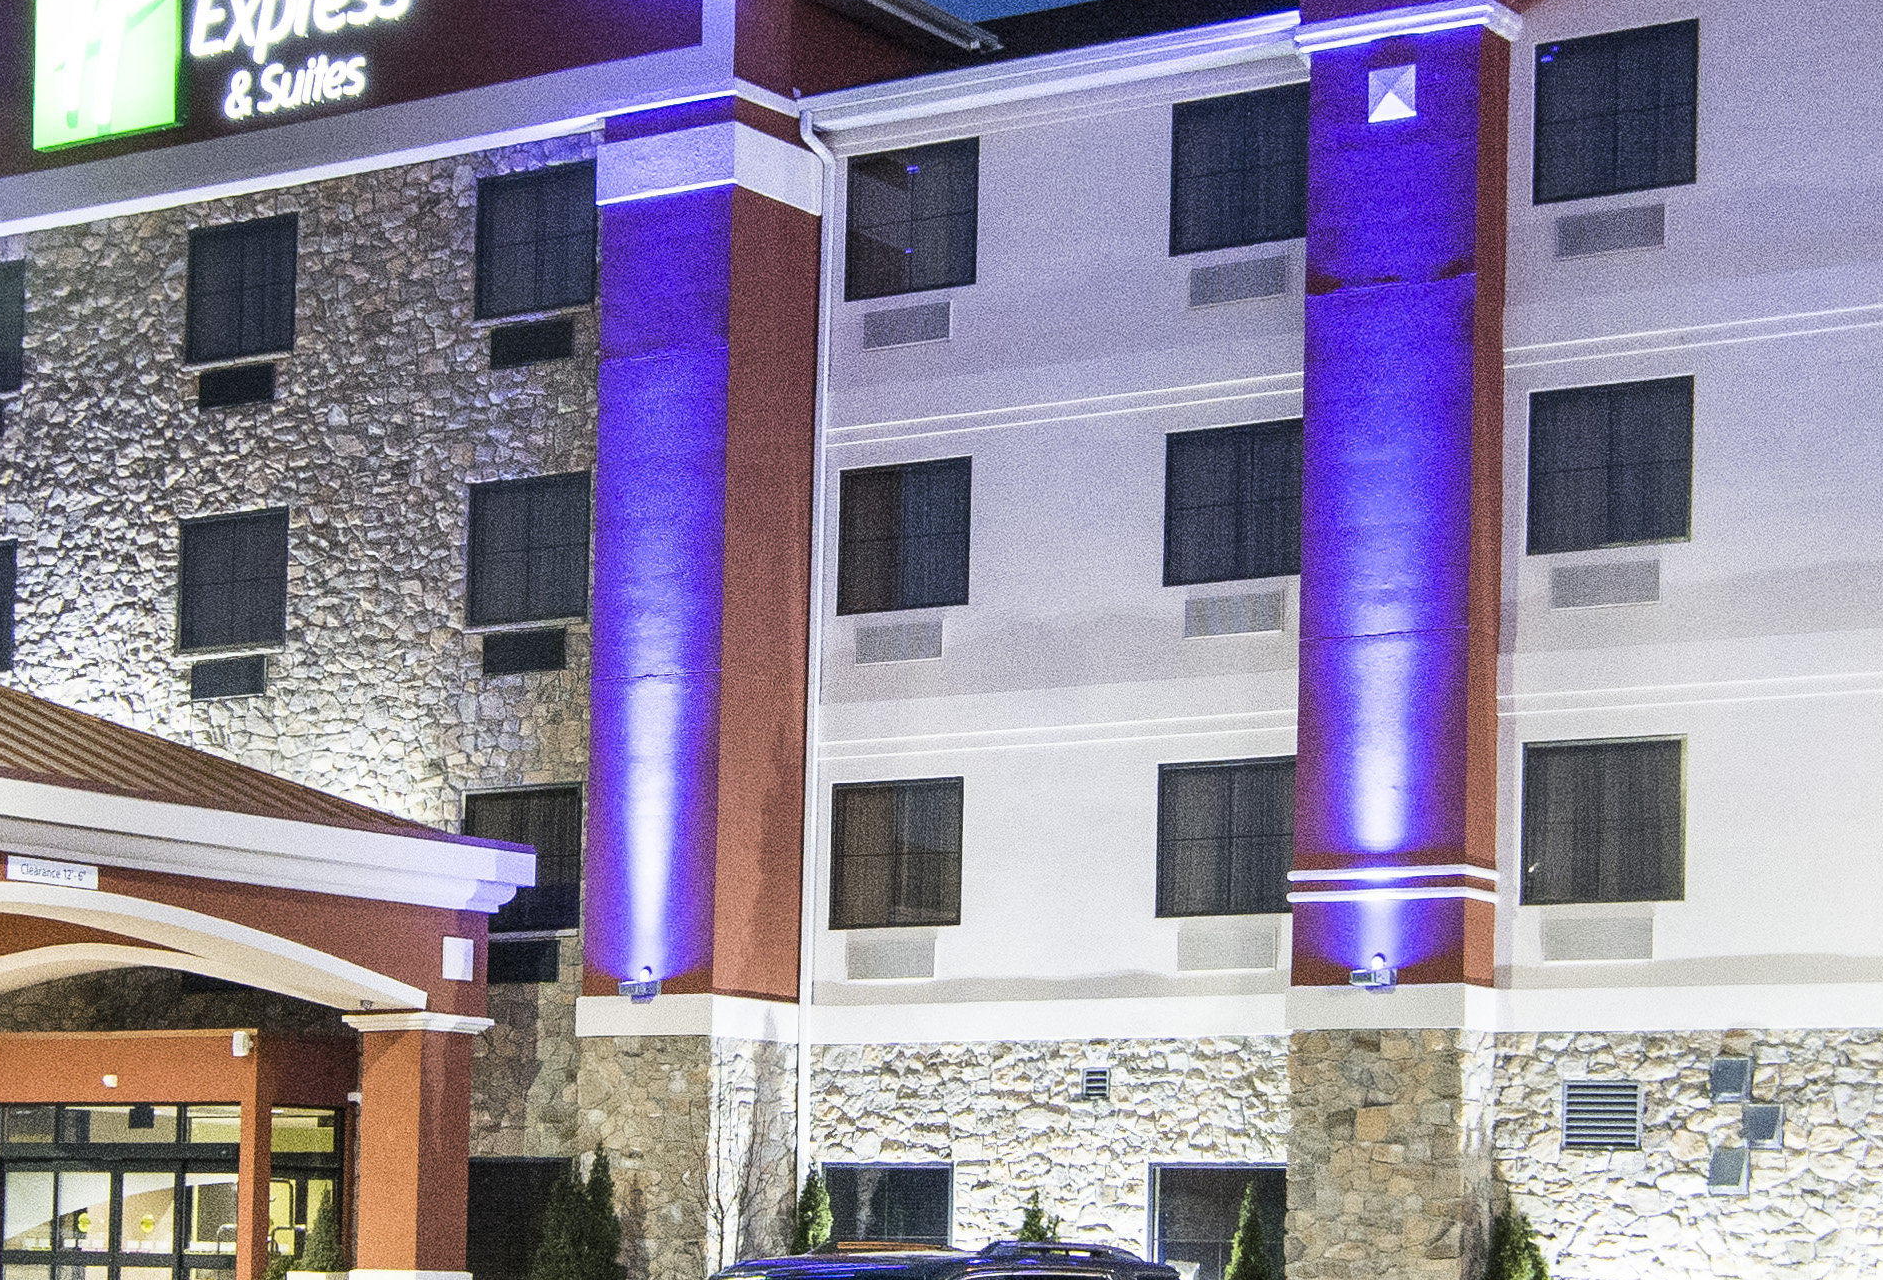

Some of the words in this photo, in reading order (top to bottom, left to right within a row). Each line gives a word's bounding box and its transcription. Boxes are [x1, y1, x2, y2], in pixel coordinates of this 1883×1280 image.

[223, 69, 253, 120] &
[256, 55, 368, 113] Suites
[20, 863, 61, 880] Clearance
